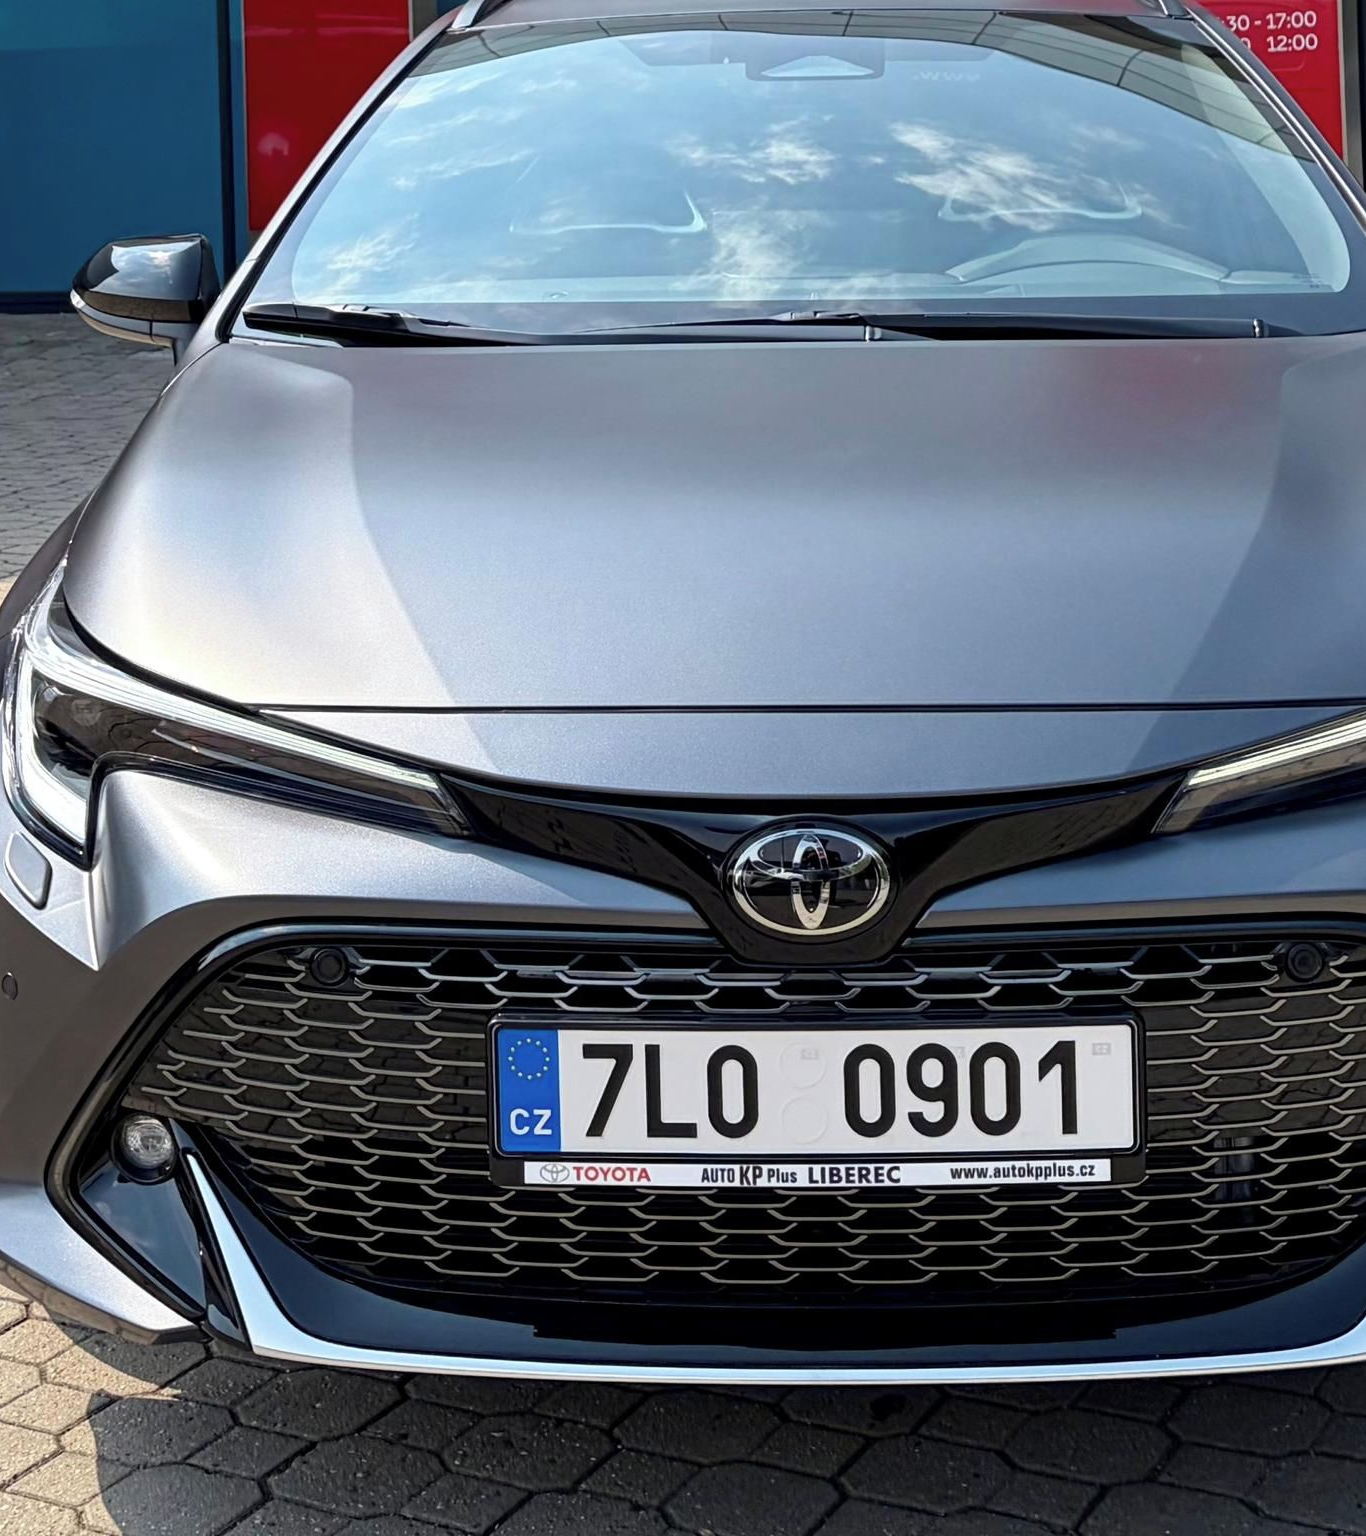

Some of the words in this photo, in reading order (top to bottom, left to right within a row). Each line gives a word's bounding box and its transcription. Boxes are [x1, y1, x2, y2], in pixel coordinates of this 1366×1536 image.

[1266, 11, 1317, 30] 17:00
[1267, 34, 1318, 52] 12:00
[582, 1043, 759, 1139] 7L0
[843, 1041, 1079, 1138] 0901
[509, 1108, 552, 1136] CZ
[572, 1166, 651, 1182] TOYOTA
[701, 1168, 735, 1184] AUTO
[739, 1165, 763, 1185] KP
[767, 1167, 798, 1184] Plus
[808, 1165, 901, 1184] LIBEREC
[950, 1162, 1096, 1181] www.autokpplus.cz
